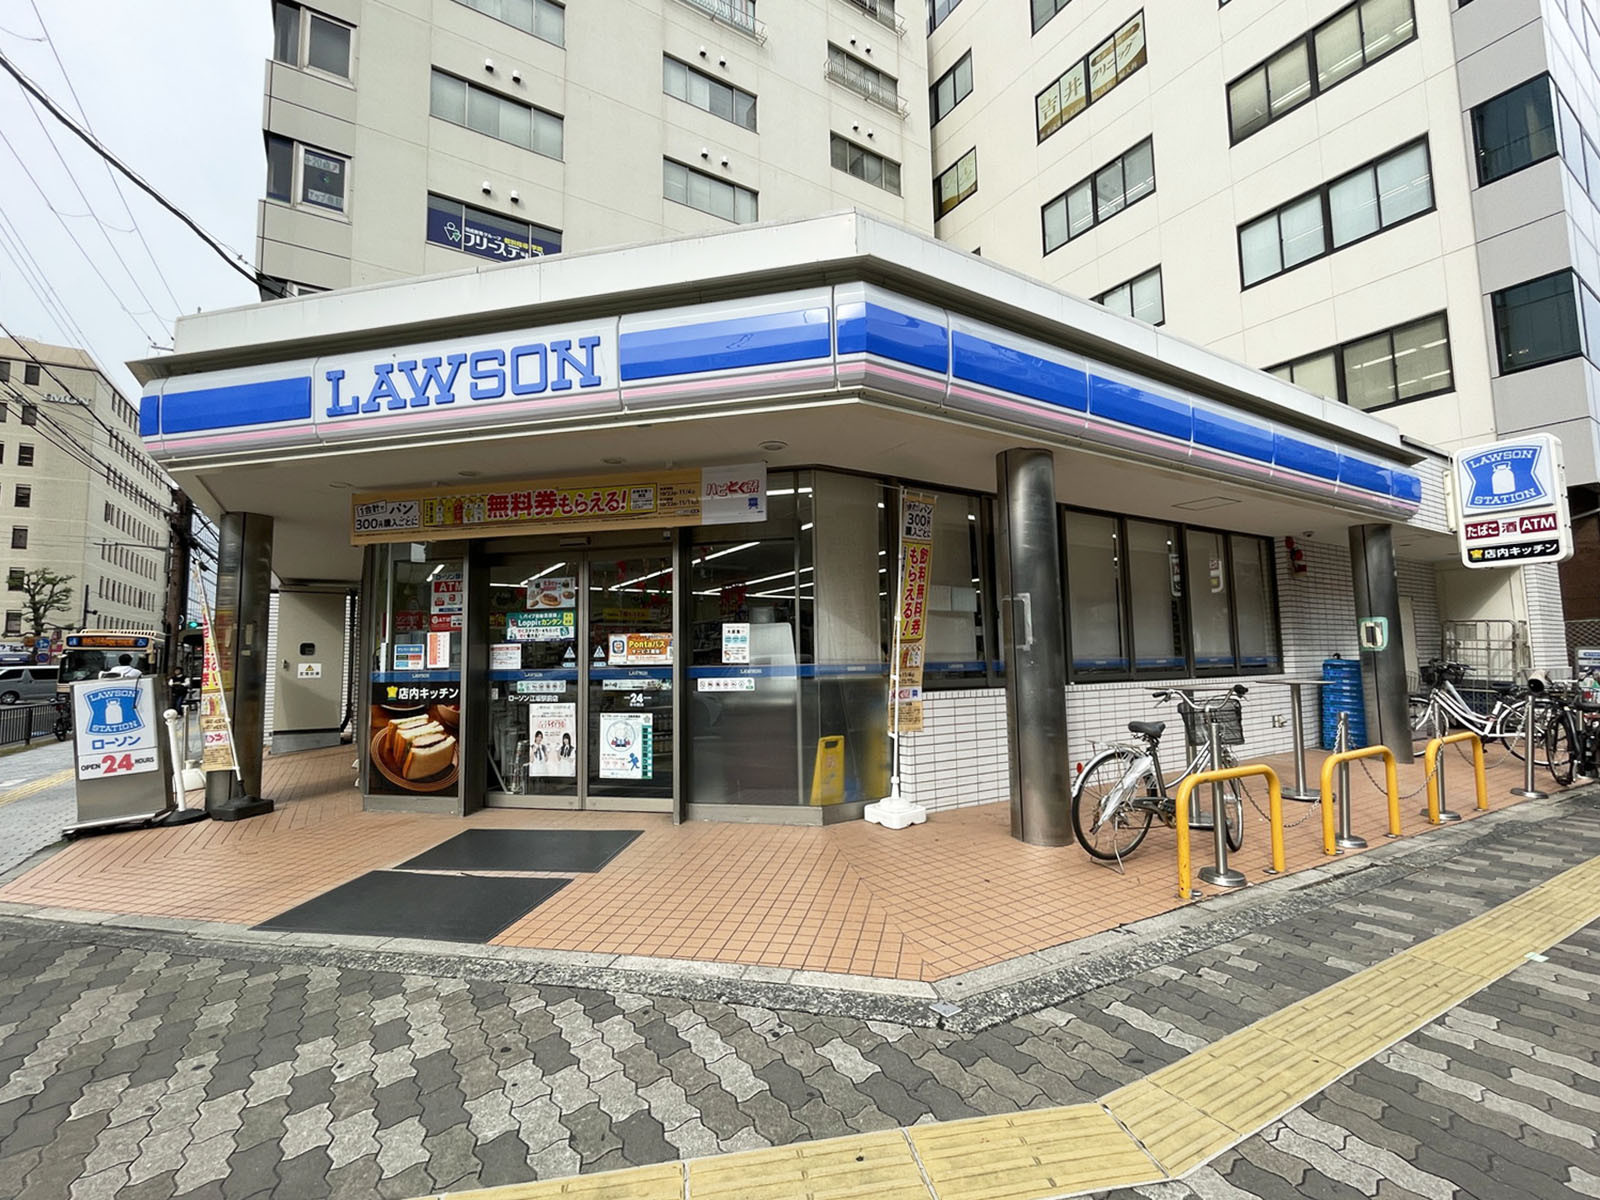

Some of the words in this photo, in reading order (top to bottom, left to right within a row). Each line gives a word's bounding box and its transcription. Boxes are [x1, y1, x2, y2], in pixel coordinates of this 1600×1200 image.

[1041, 77, 1083, 121] 吉井
[1091, 42, 1133, 83] クリニック
[326, 335, 601, 417] LAWSON
[1469, 449, 1534, 469] LAWSON
[487, 490, 627, 518] 無料券もらえる!
[1473, 487, 1537, 505] STATION
[389, 503, 414, 515] パン
[1467, 523, 1499, 537] たばこ
[1501, 521, 1518, 533] 酒
[1521, 516, 1556, 531] ATM
[1484, 543, 1557, 559] 店内キッチン
[902, 547, 919, 637] もらえる!
[628, 640, 666, 648] Pontaパス
[89, 690, 136, 701] LAWSON
[398, 687, 459, 700] 店内キッチン
[629, 692, 644, 703] 24
[92, 720, 138, 732] STATION
[92, 735, 141, 750] ローソン
[81, 763, 101, 771] OPEN
[101, 753, 135, 774] 24
[134, 756, 155, 764] HOURS
